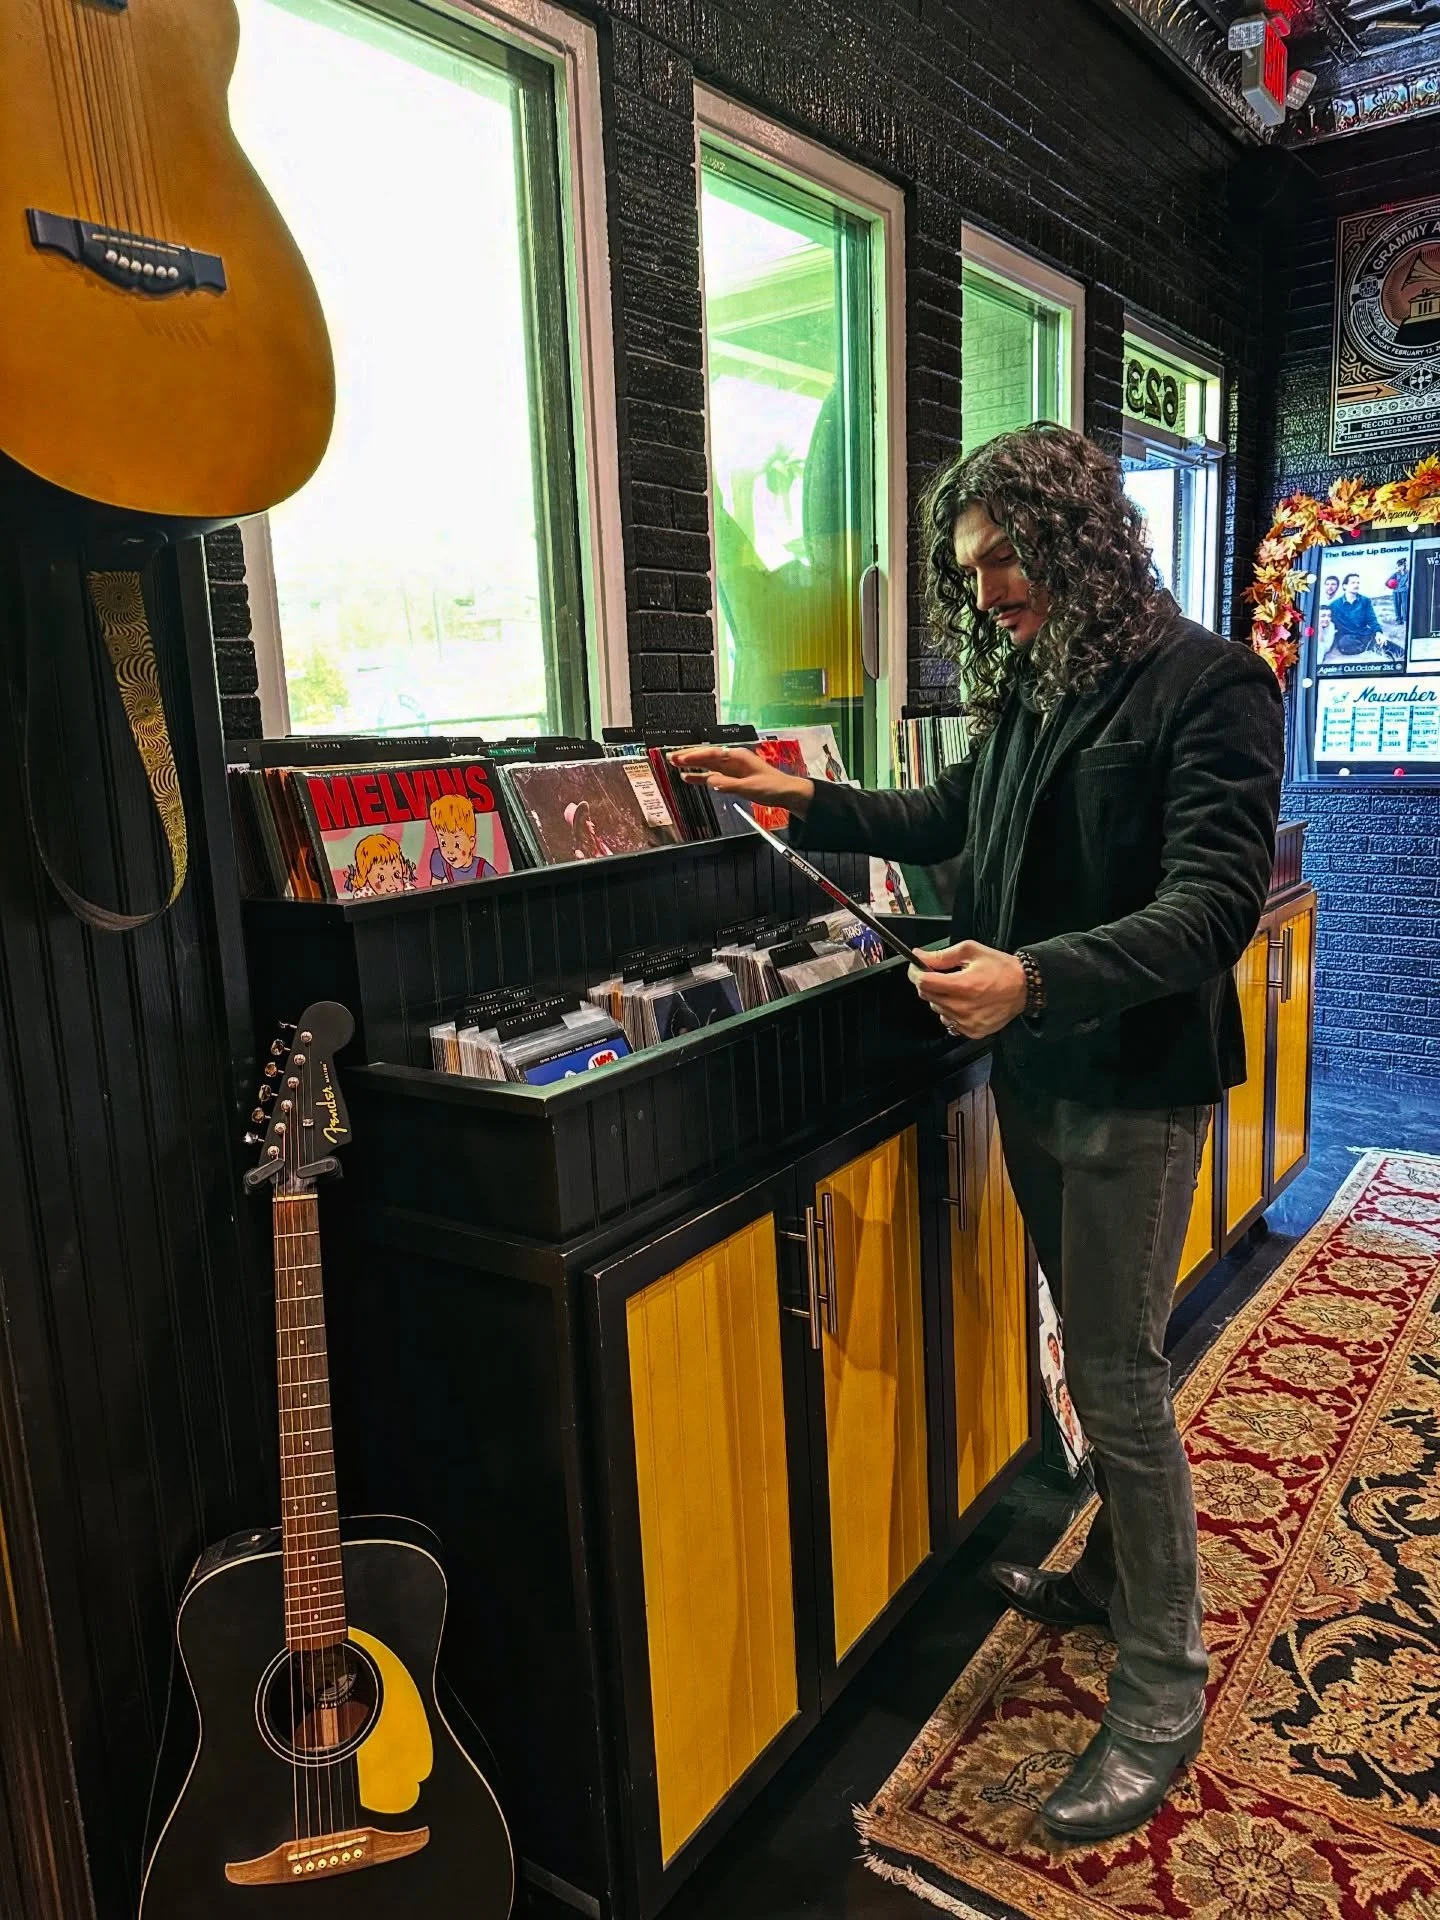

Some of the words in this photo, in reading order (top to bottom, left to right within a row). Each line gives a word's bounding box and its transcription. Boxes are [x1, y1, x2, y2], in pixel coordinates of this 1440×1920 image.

[1372, 224, 1428, 270] GRAMMY
[1391, 347, 1425, 356] FEBRUARY
[1361, 417, 1395, 430] RECORD
[1396, 413, 1424, 424] STORE
[1425, 412, 1437, 420] OF
[1344, 432, 1362, 440] THIRD
[1380, 427, 1410, 435] RECORDS
[1325, 551, 1339, 559] The
[1380, 546, 1410, 554] Bombs
[1356, 664, 1382, 672] October
[1353, 685, 1438, 703] November
[307, 766, 495, 830] MELVINS
[790, 855, 820, 881] MELVINS
[315, 1085, 348, 1144] Fender
